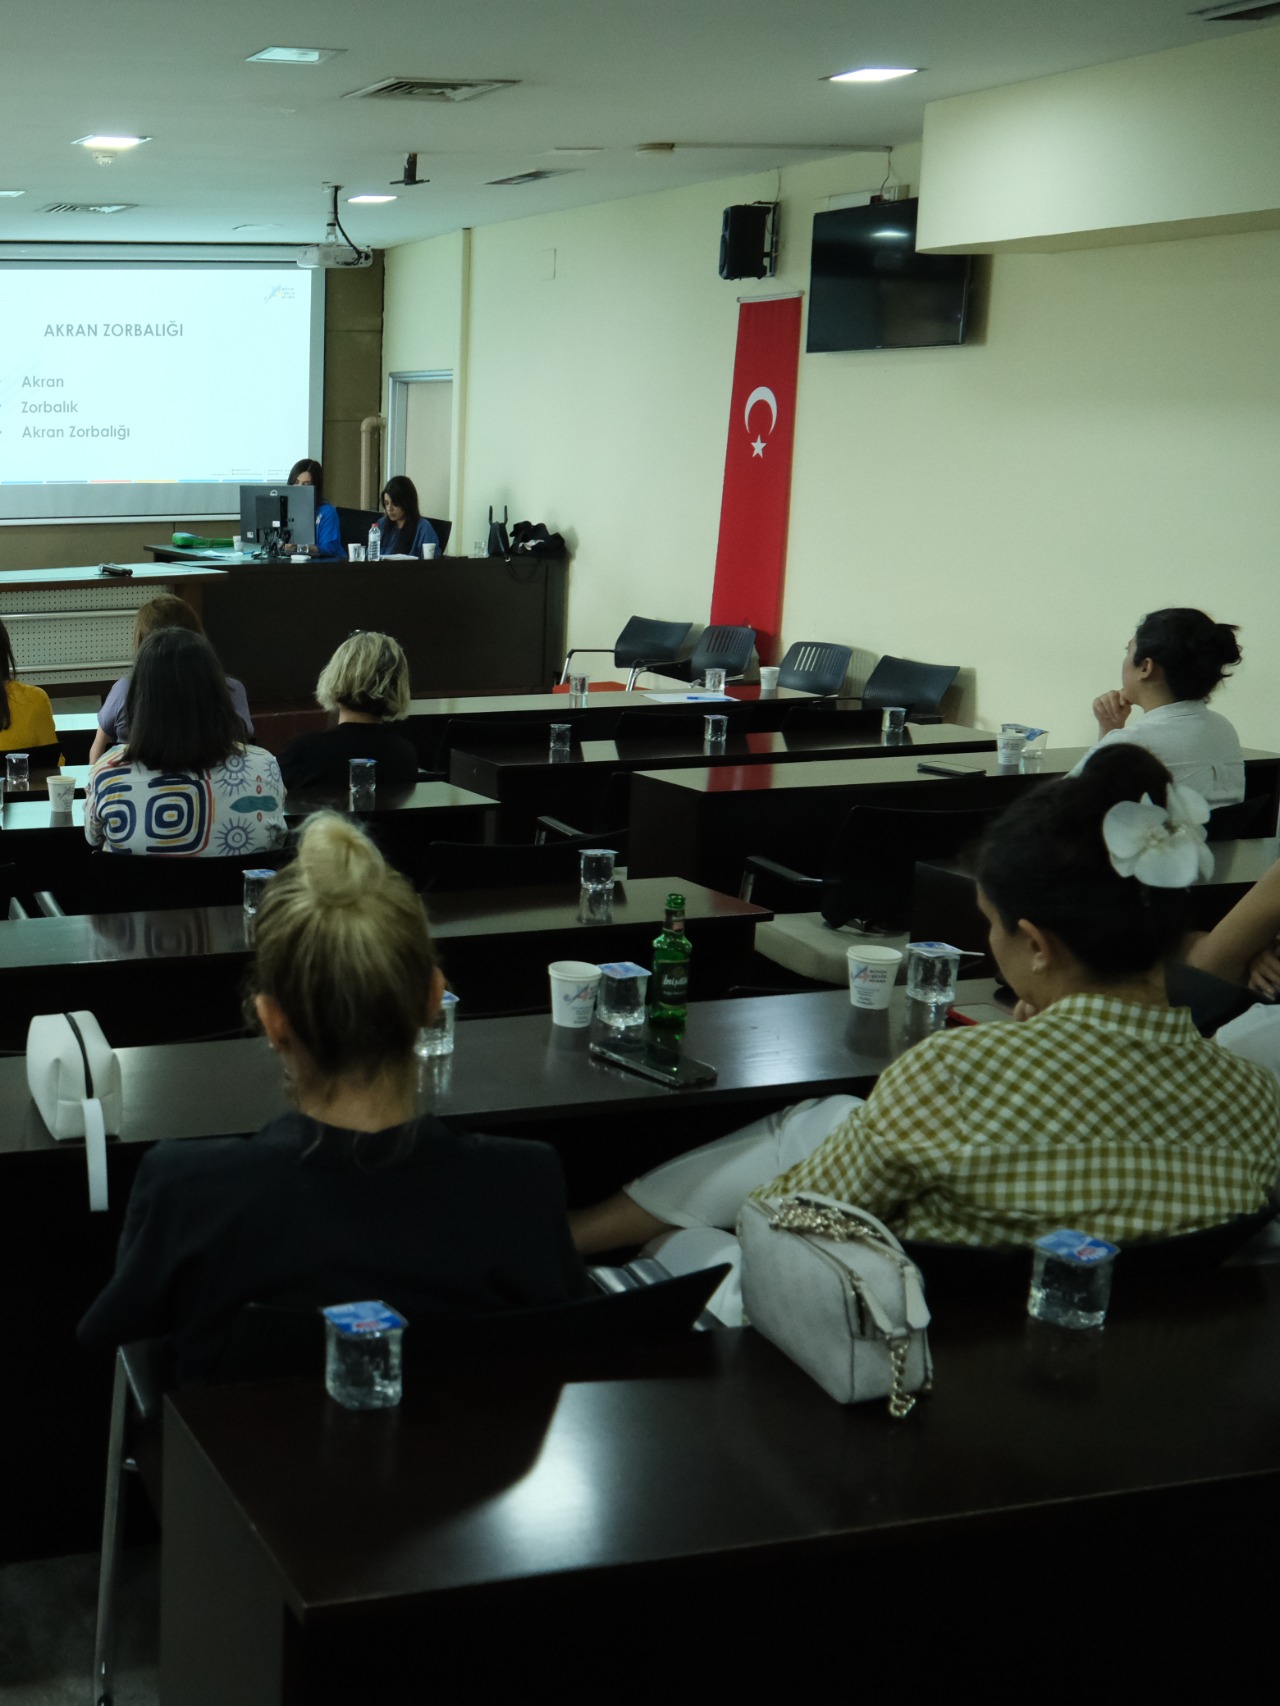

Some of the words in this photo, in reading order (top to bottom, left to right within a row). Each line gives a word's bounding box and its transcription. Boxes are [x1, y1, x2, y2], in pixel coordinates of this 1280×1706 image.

[43, 323, 98, 337] AKRAN
[103, 320, 183, 337] ZORBALIĞI
[21, 375, 64, 389] Akran
[20, 400, 79, 414] Zorbalık
[21, 425, 65, 439] Akran
[68, 424, 131, 441] Zorbalığı
